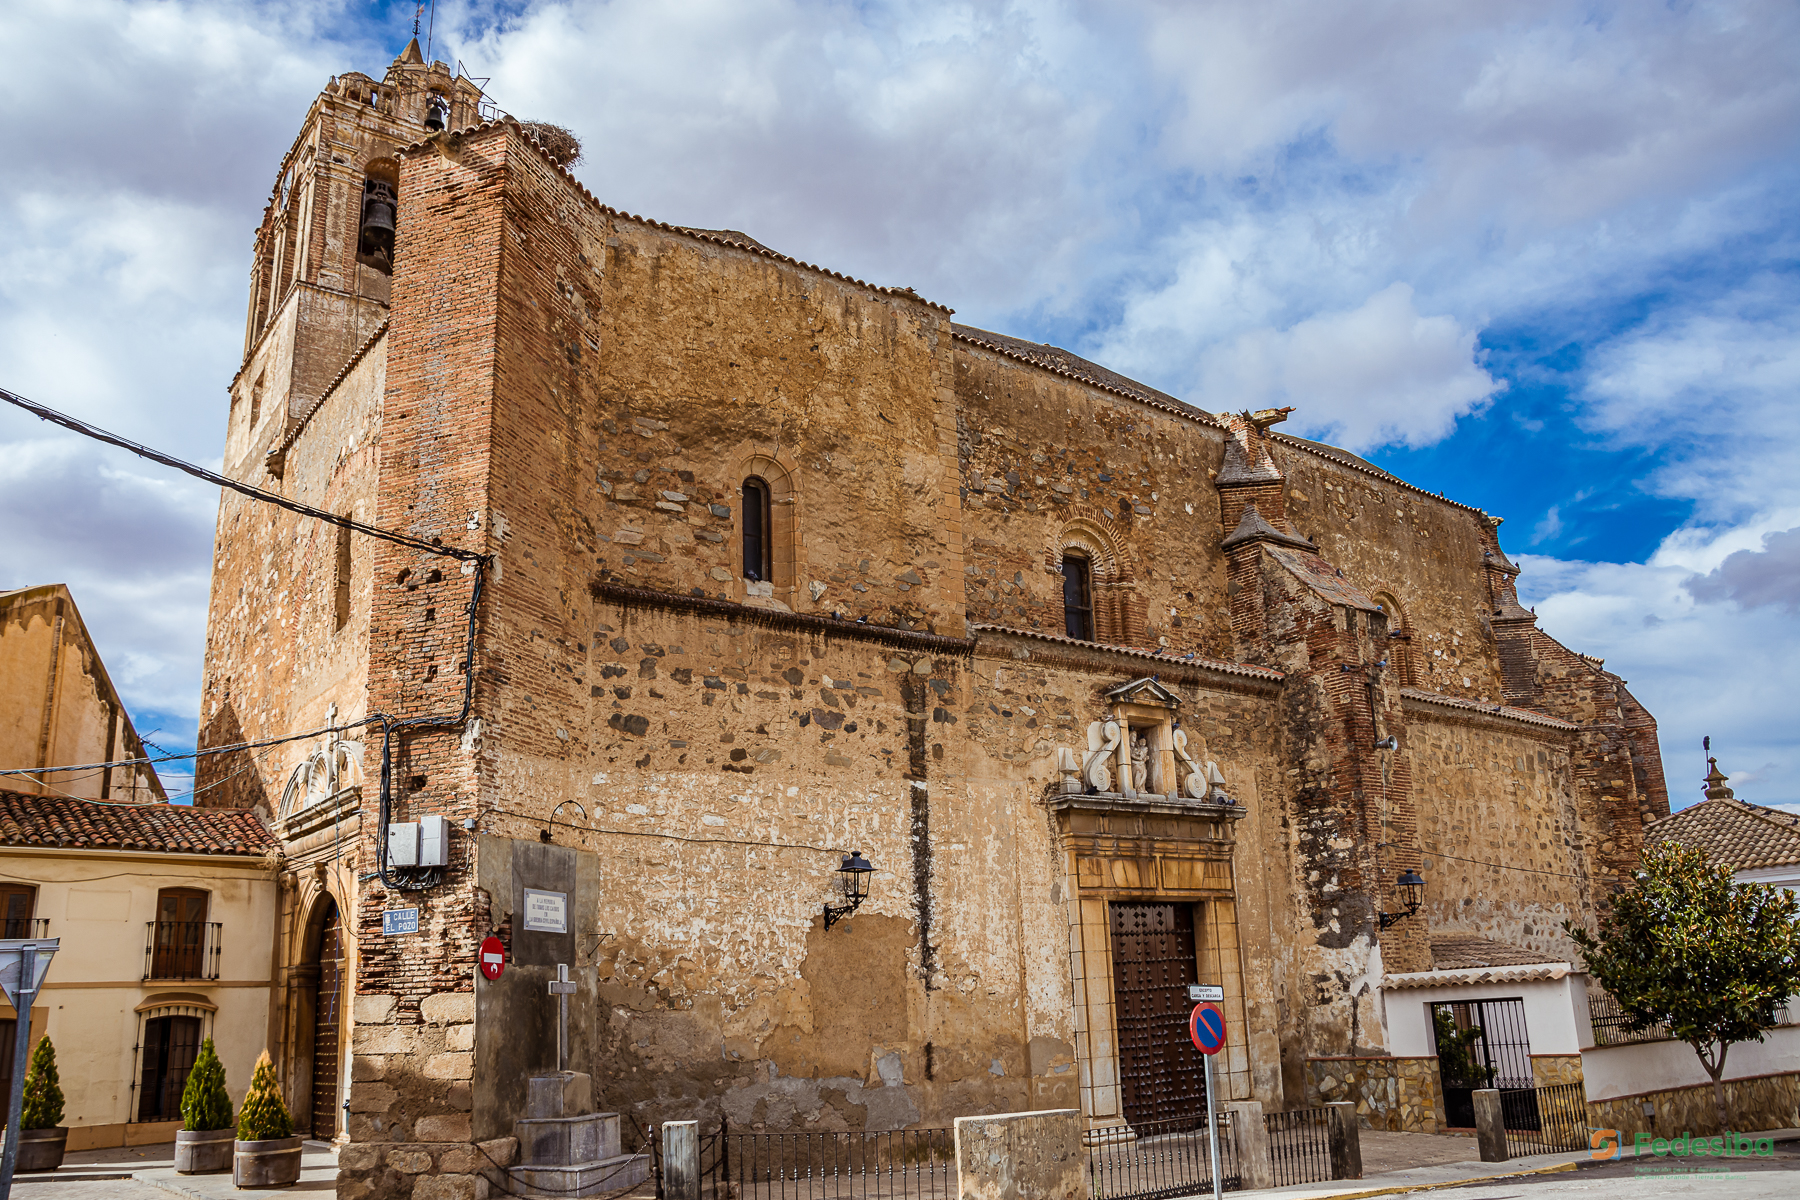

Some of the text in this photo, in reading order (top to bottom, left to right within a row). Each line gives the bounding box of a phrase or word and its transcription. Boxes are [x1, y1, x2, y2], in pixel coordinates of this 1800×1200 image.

[393, 911, 415, 921] CALLE
[385, 921, 416, 932] EL POZO
